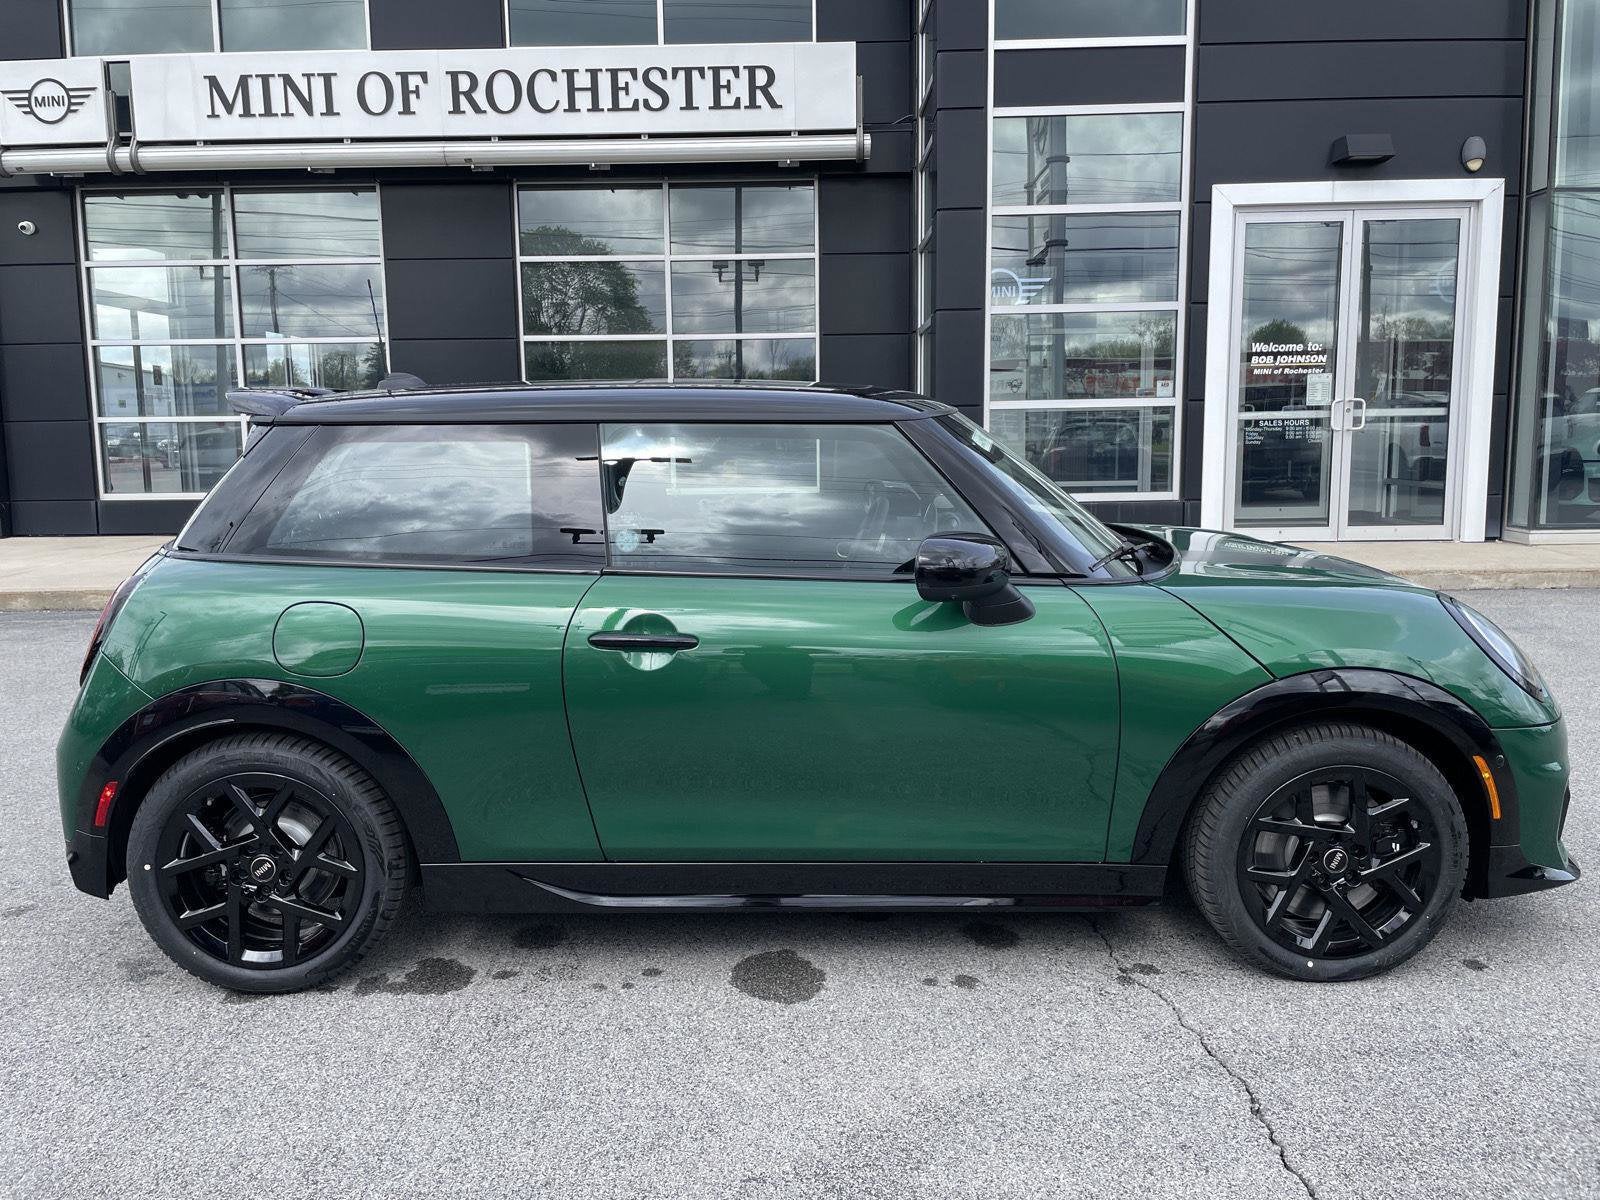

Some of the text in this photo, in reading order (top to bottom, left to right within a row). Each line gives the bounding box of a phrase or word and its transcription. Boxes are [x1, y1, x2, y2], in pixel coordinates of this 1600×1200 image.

[203, 65, 783, 118] MINI OF ROCHESTER
[34, 95, 66, 108] MINI
[1251, 341, 1323, 352] Welcome to:
[1251, 354, 1328, 365] BOB JOHNSON
[1284, 367, 1324, 375] Rochester
[1329, 852, 1343, 869] MINI
[254, 861, 272, 877] MINI
